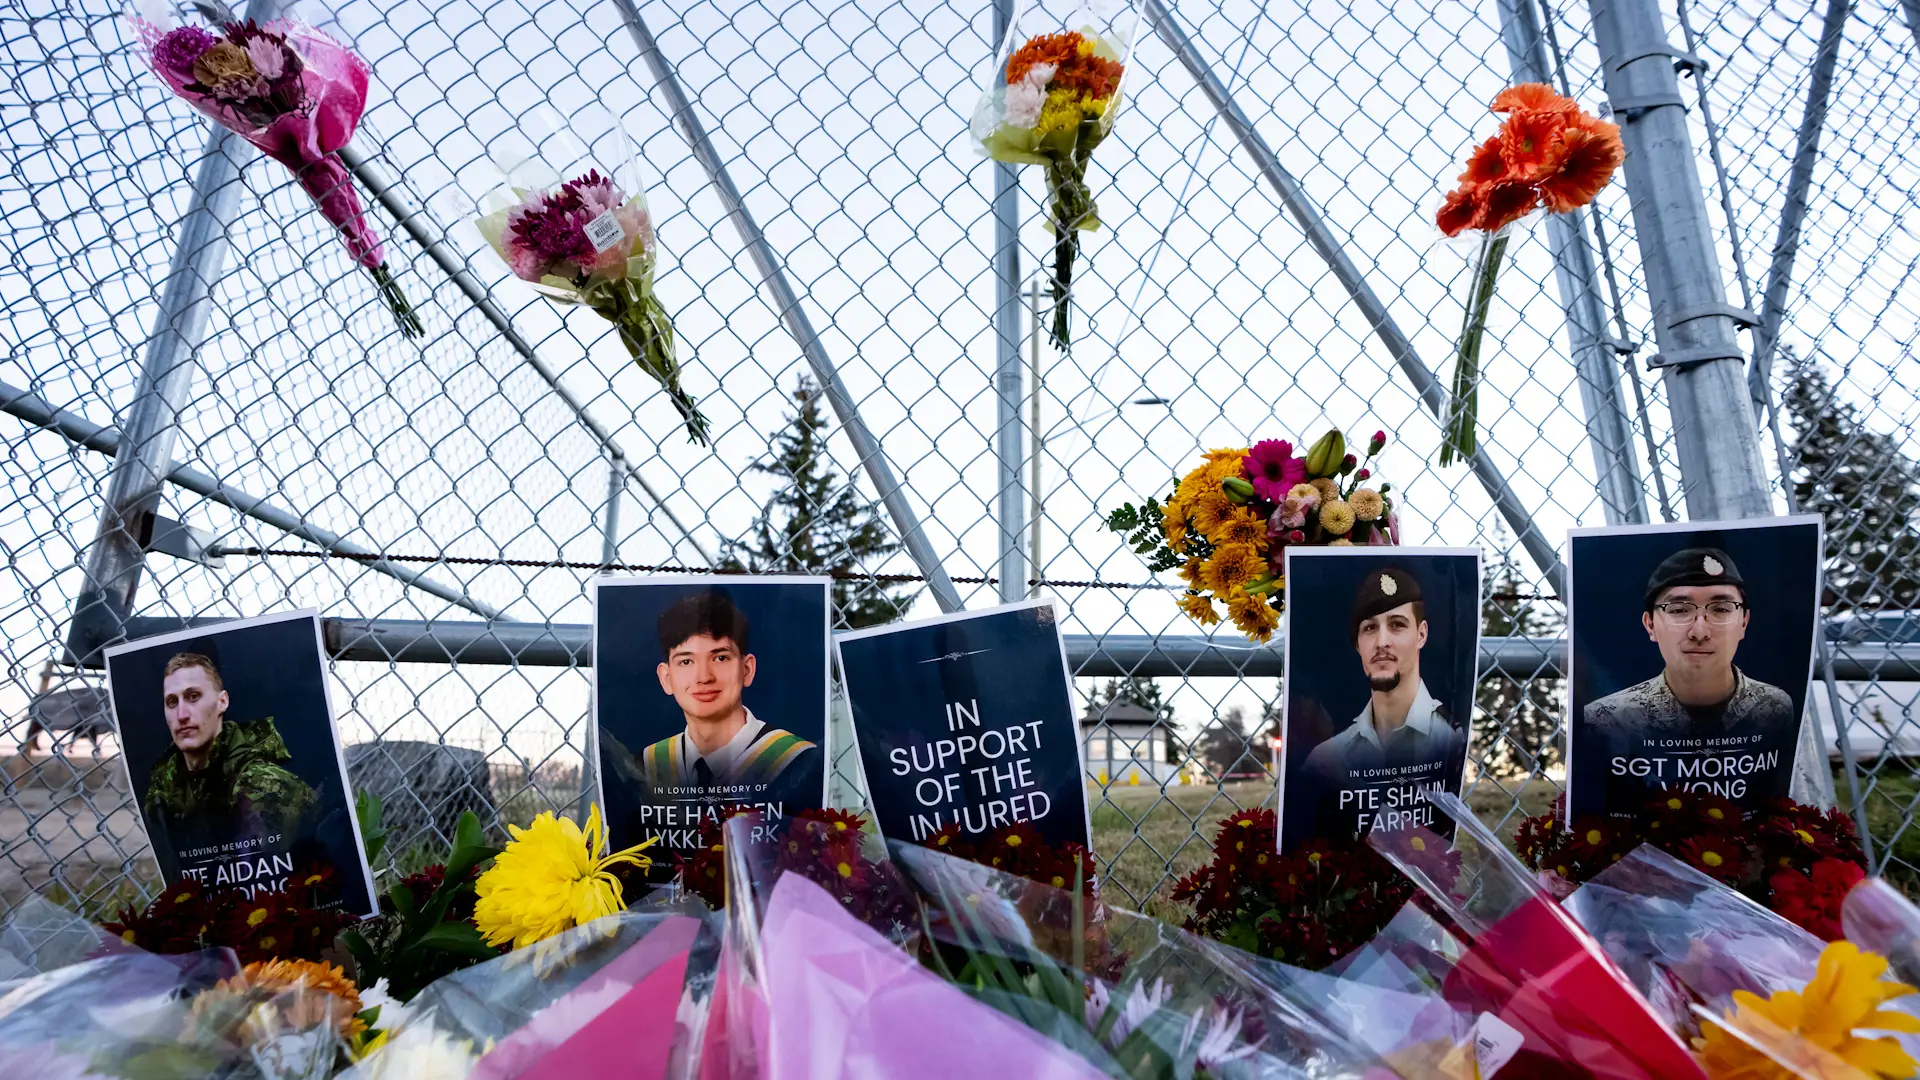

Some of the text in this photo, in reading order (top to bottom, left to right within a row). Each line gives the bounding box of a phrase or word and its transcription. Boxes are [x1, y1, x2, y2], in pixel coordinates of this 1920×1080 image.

[946, 698, 981, 732] IN
[889, 720, 1044, 776] SUPPORT
[1644, 734, 1763, 747] IN LOVING MEMORY OF
[1350, 761, 1443, 778] IN LOVING MEMORY OF
[1611, 749, 1779, 778] SGT MORGAN
[668, 786, 704, 794] LOVING
[708, 784, 751, 794] MEMORY
[755, 783, 768, 792] OF
[915, 758, 1035, 807] OF THE
[1339, 779, 1446, 811] PTE SHAUN
[640, 801, 783, 826] PTE HAEN
[909, 790, 1051, 841] INJURED
[188, 845, 219, 858] LOVING
[221, 838, 264, 852] MEMORY
[268, 834, 282, 844] OF
[645, 824, 780, 850] LYKKERK
[216, 852, 294, 886] AIDAN
